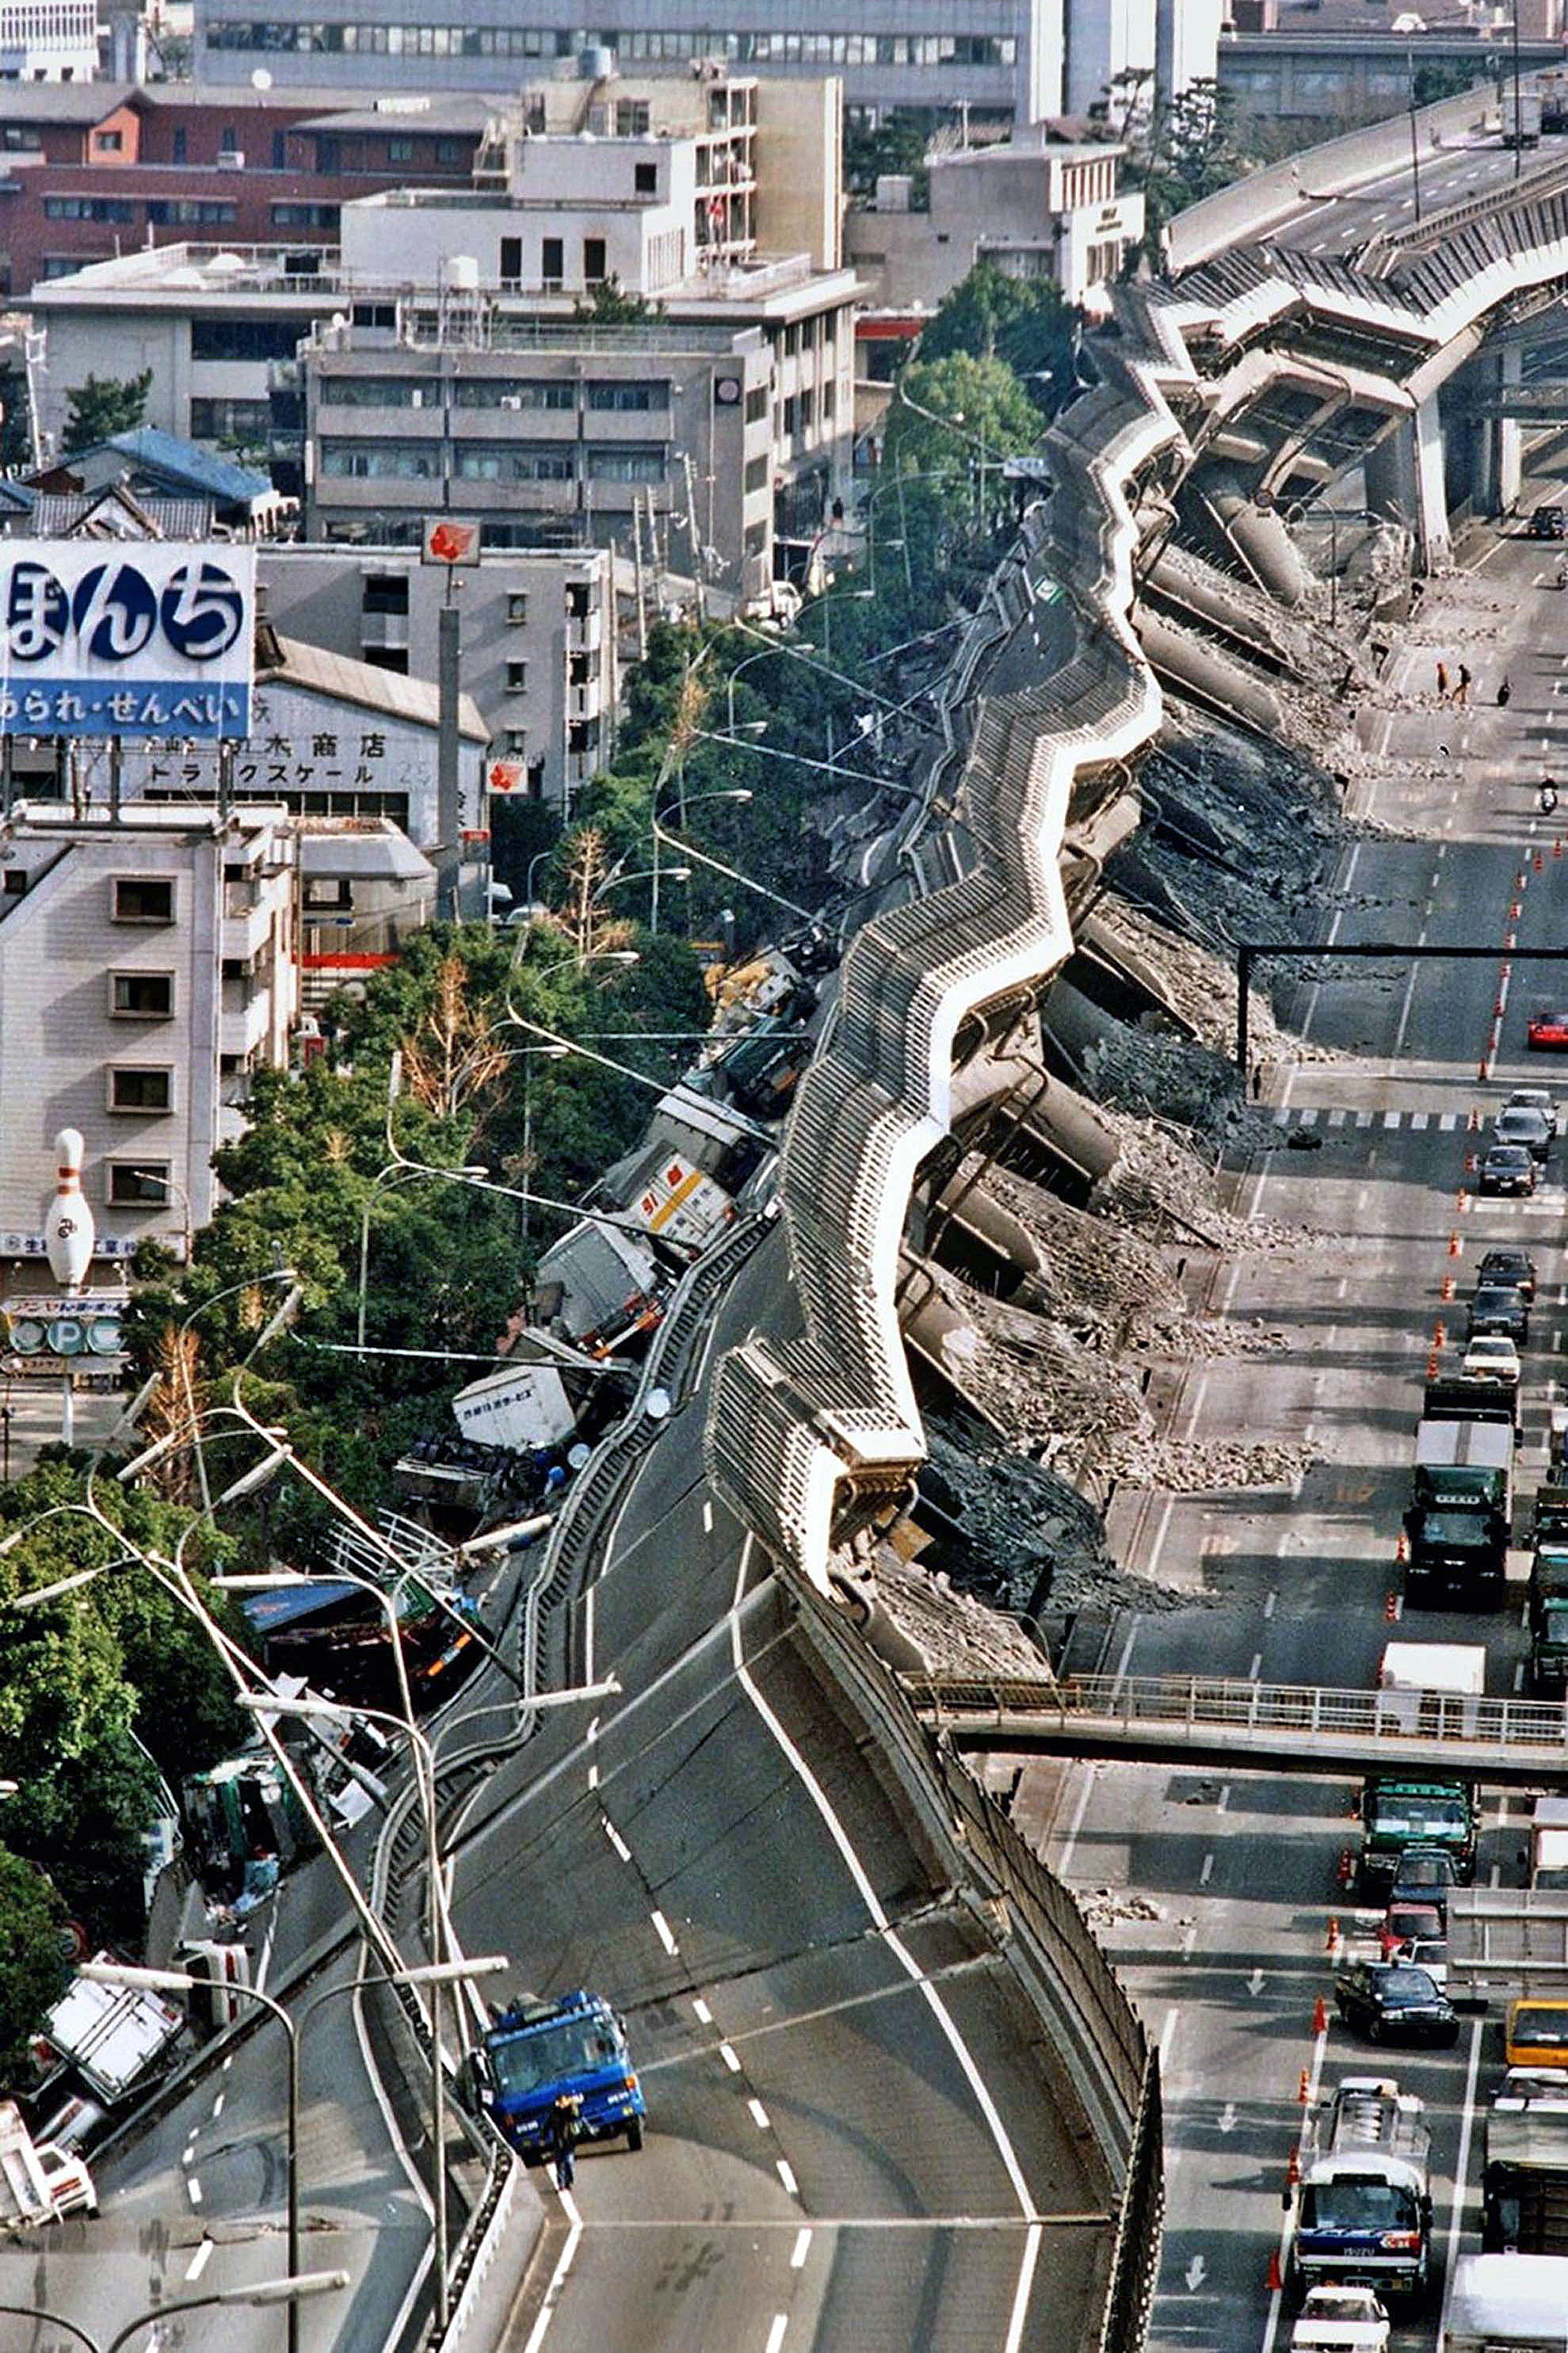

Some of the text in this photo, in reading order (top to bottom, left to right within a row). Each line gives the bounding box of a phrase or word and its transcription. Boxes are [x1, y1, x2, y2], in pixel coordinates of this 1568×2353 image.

[2, 558, 242, 659] ぼんち
[151, 763, 374, 784] トラクスケール
